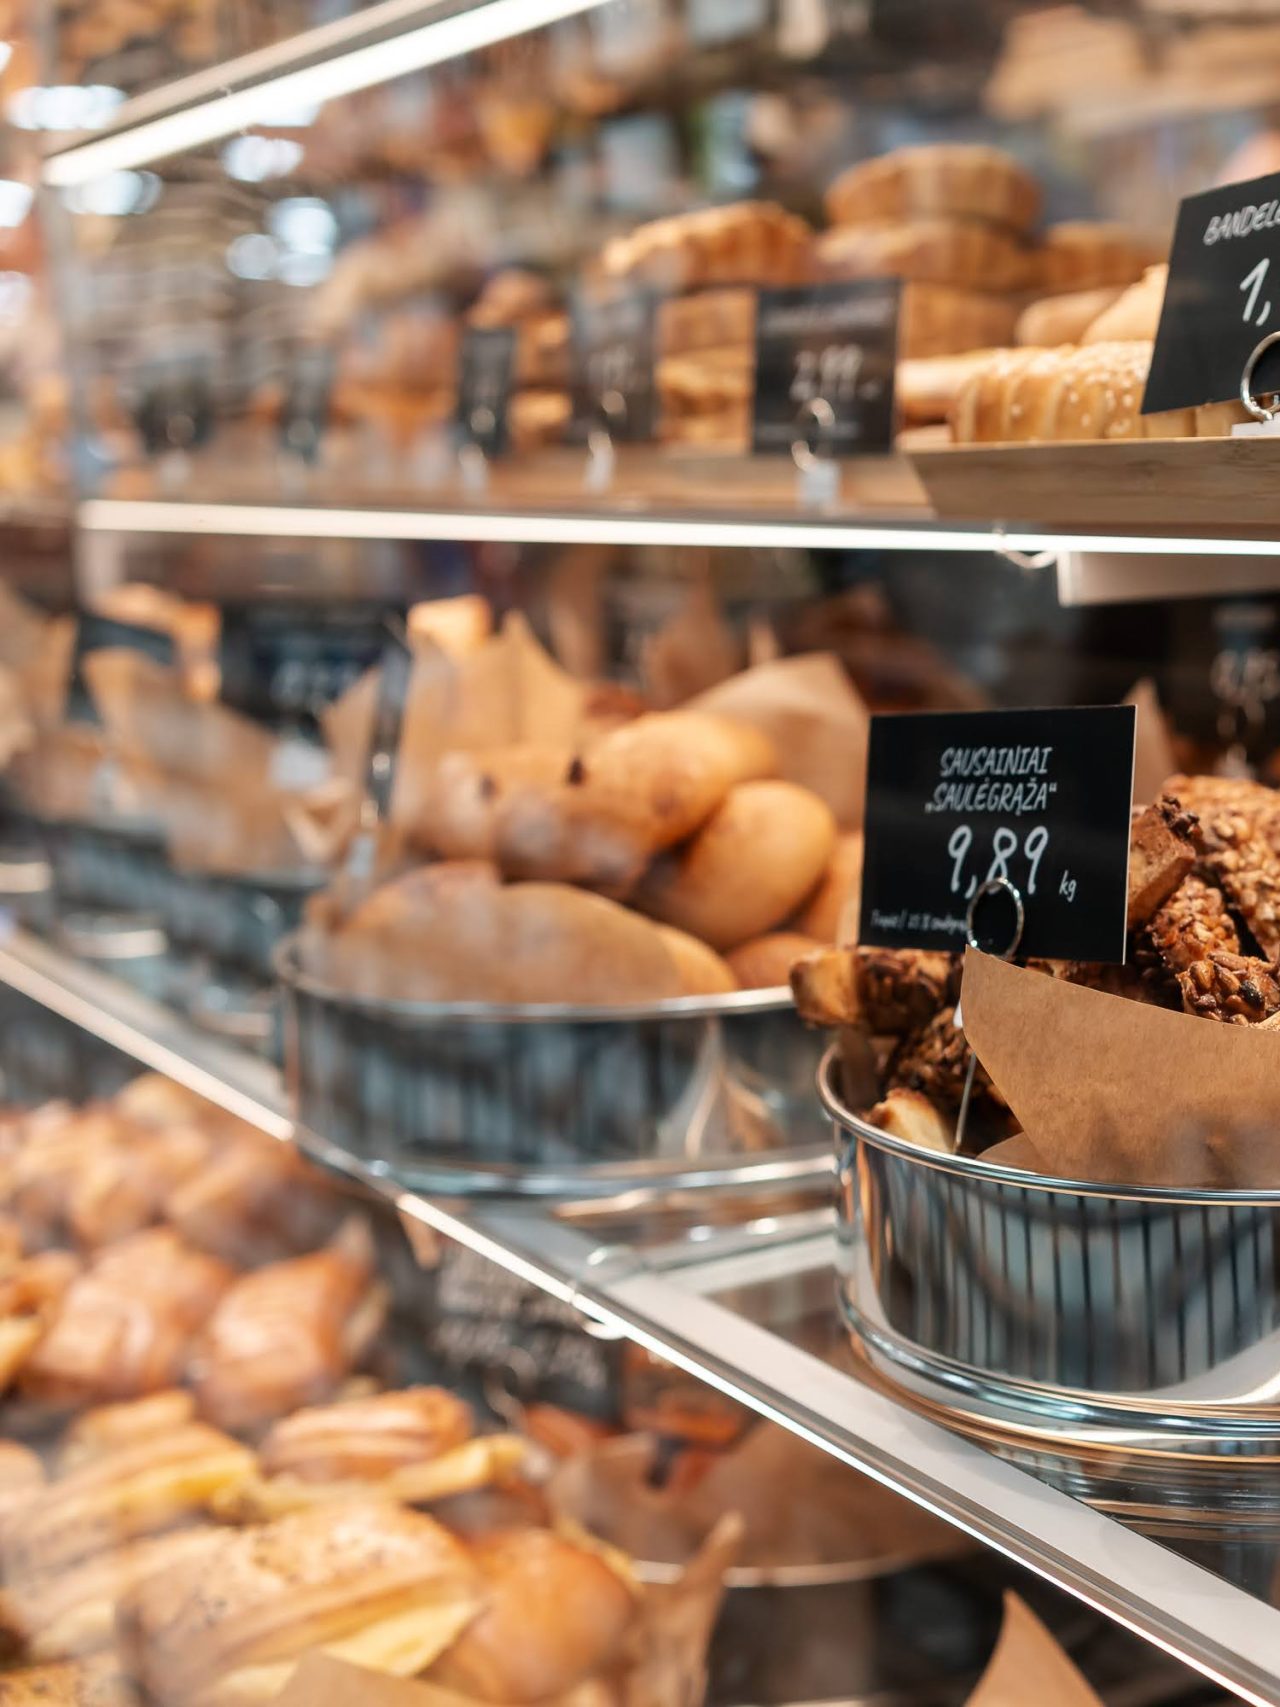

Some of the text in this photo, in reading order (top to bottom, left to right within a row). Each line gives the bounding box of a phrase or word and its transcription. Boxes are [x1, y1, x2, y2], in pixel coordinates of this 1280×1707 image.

[940, 746, 1053, 777] SAUSAINIAI
[948, 825, 1048, 898] 9,89
[1058, 869, 1077, 902] kg
